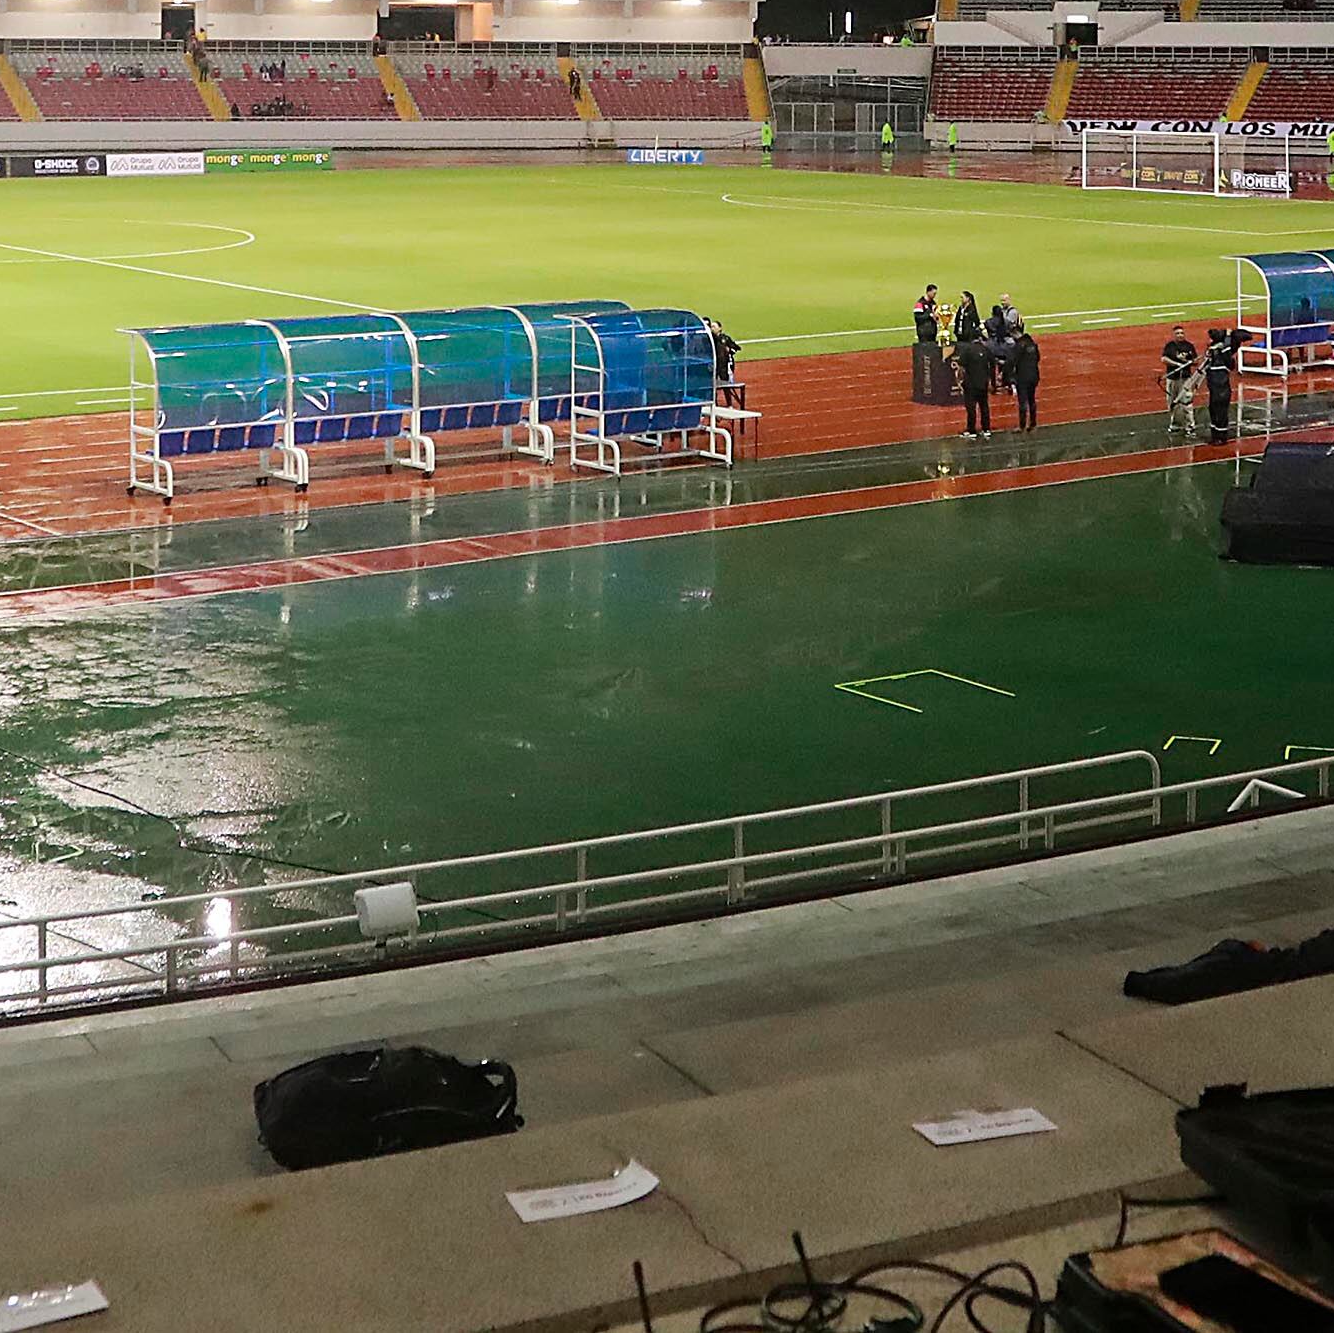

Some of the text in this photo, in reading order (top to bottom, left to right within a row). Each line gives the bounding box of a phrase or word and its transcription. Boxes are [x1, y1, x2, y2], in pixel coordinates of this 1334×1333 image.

[1151, 121, 1212, 133] CON
[1225, 122, 1275, 136] LOS
[206, 152, 329, 166] monge monge monge
[630, 149, 702, 163] LIBERTY
